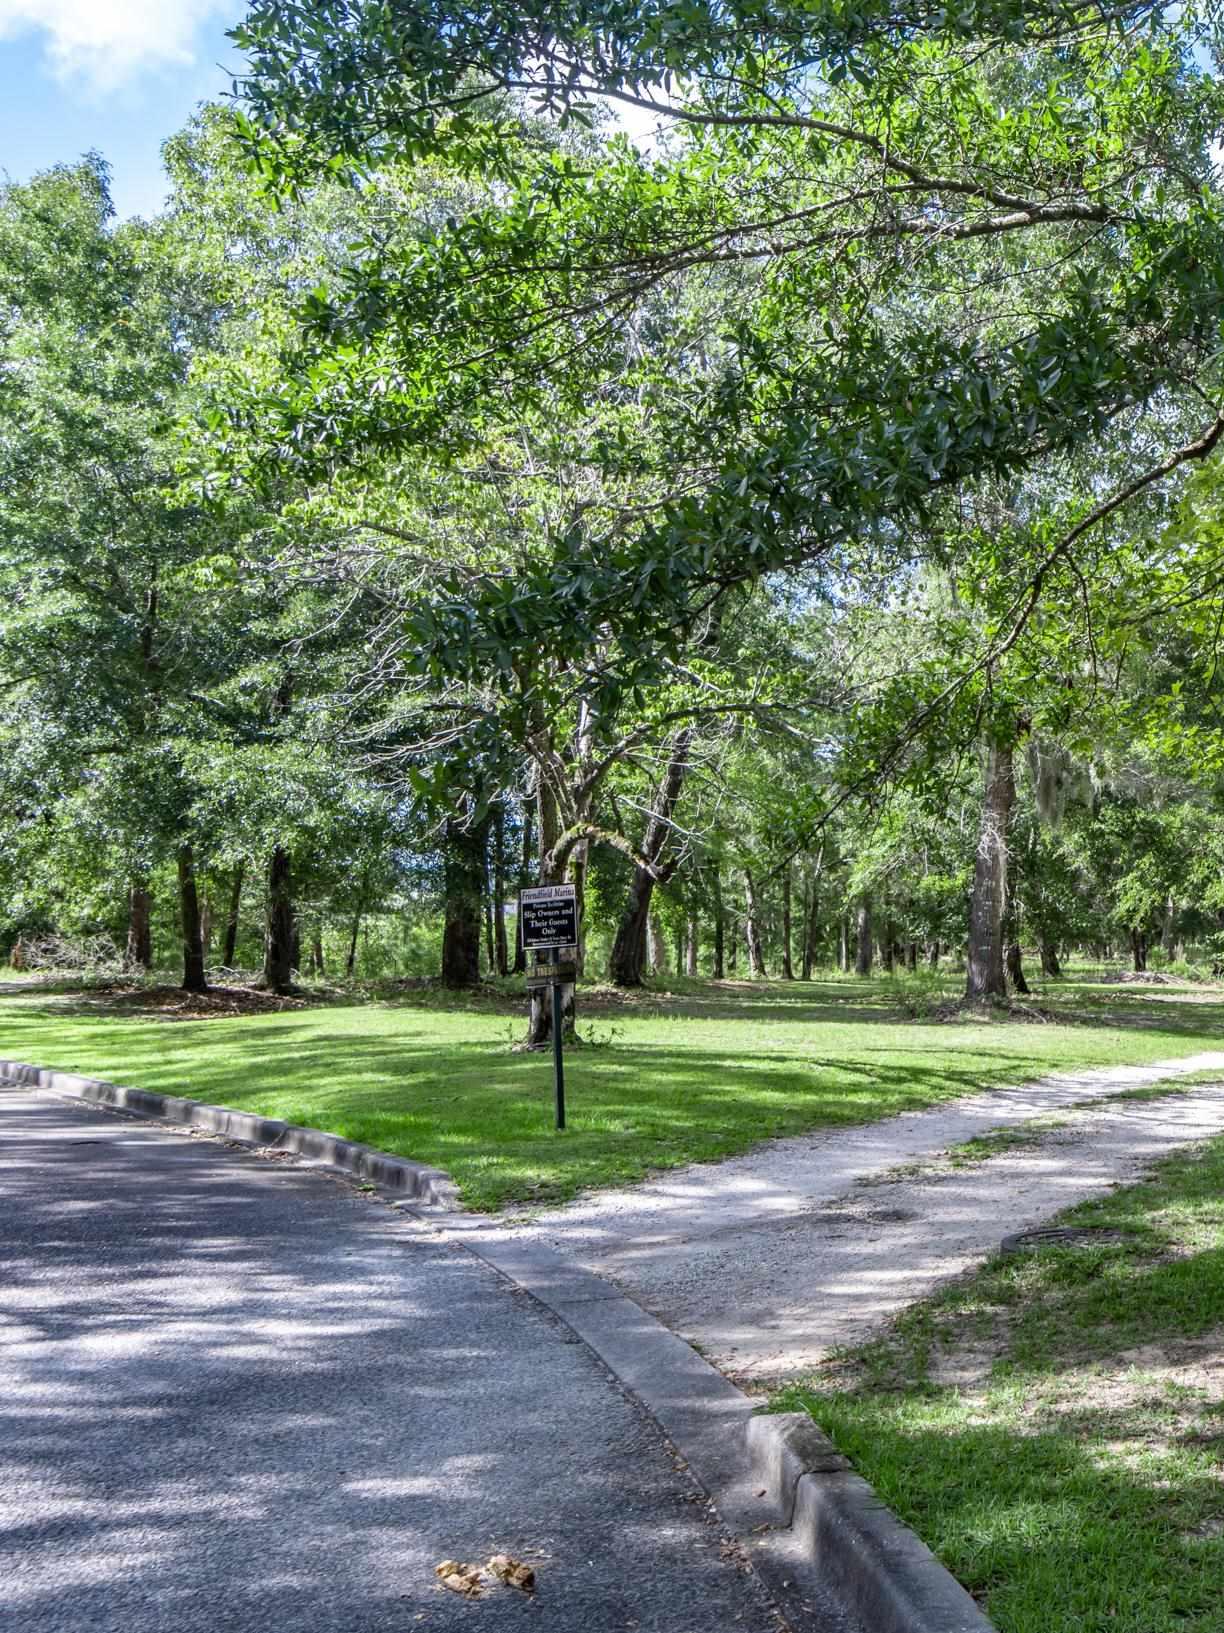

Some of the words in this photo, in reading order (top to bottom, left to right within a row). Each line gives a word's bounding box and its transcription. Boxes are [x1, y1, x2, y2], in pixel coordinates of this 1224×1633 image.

[554, 887, 575, 897] Marina
[561, 906, 573, 914] and
[529, 920, 547, 928] Their
[542, 927, 556, 935] Only
